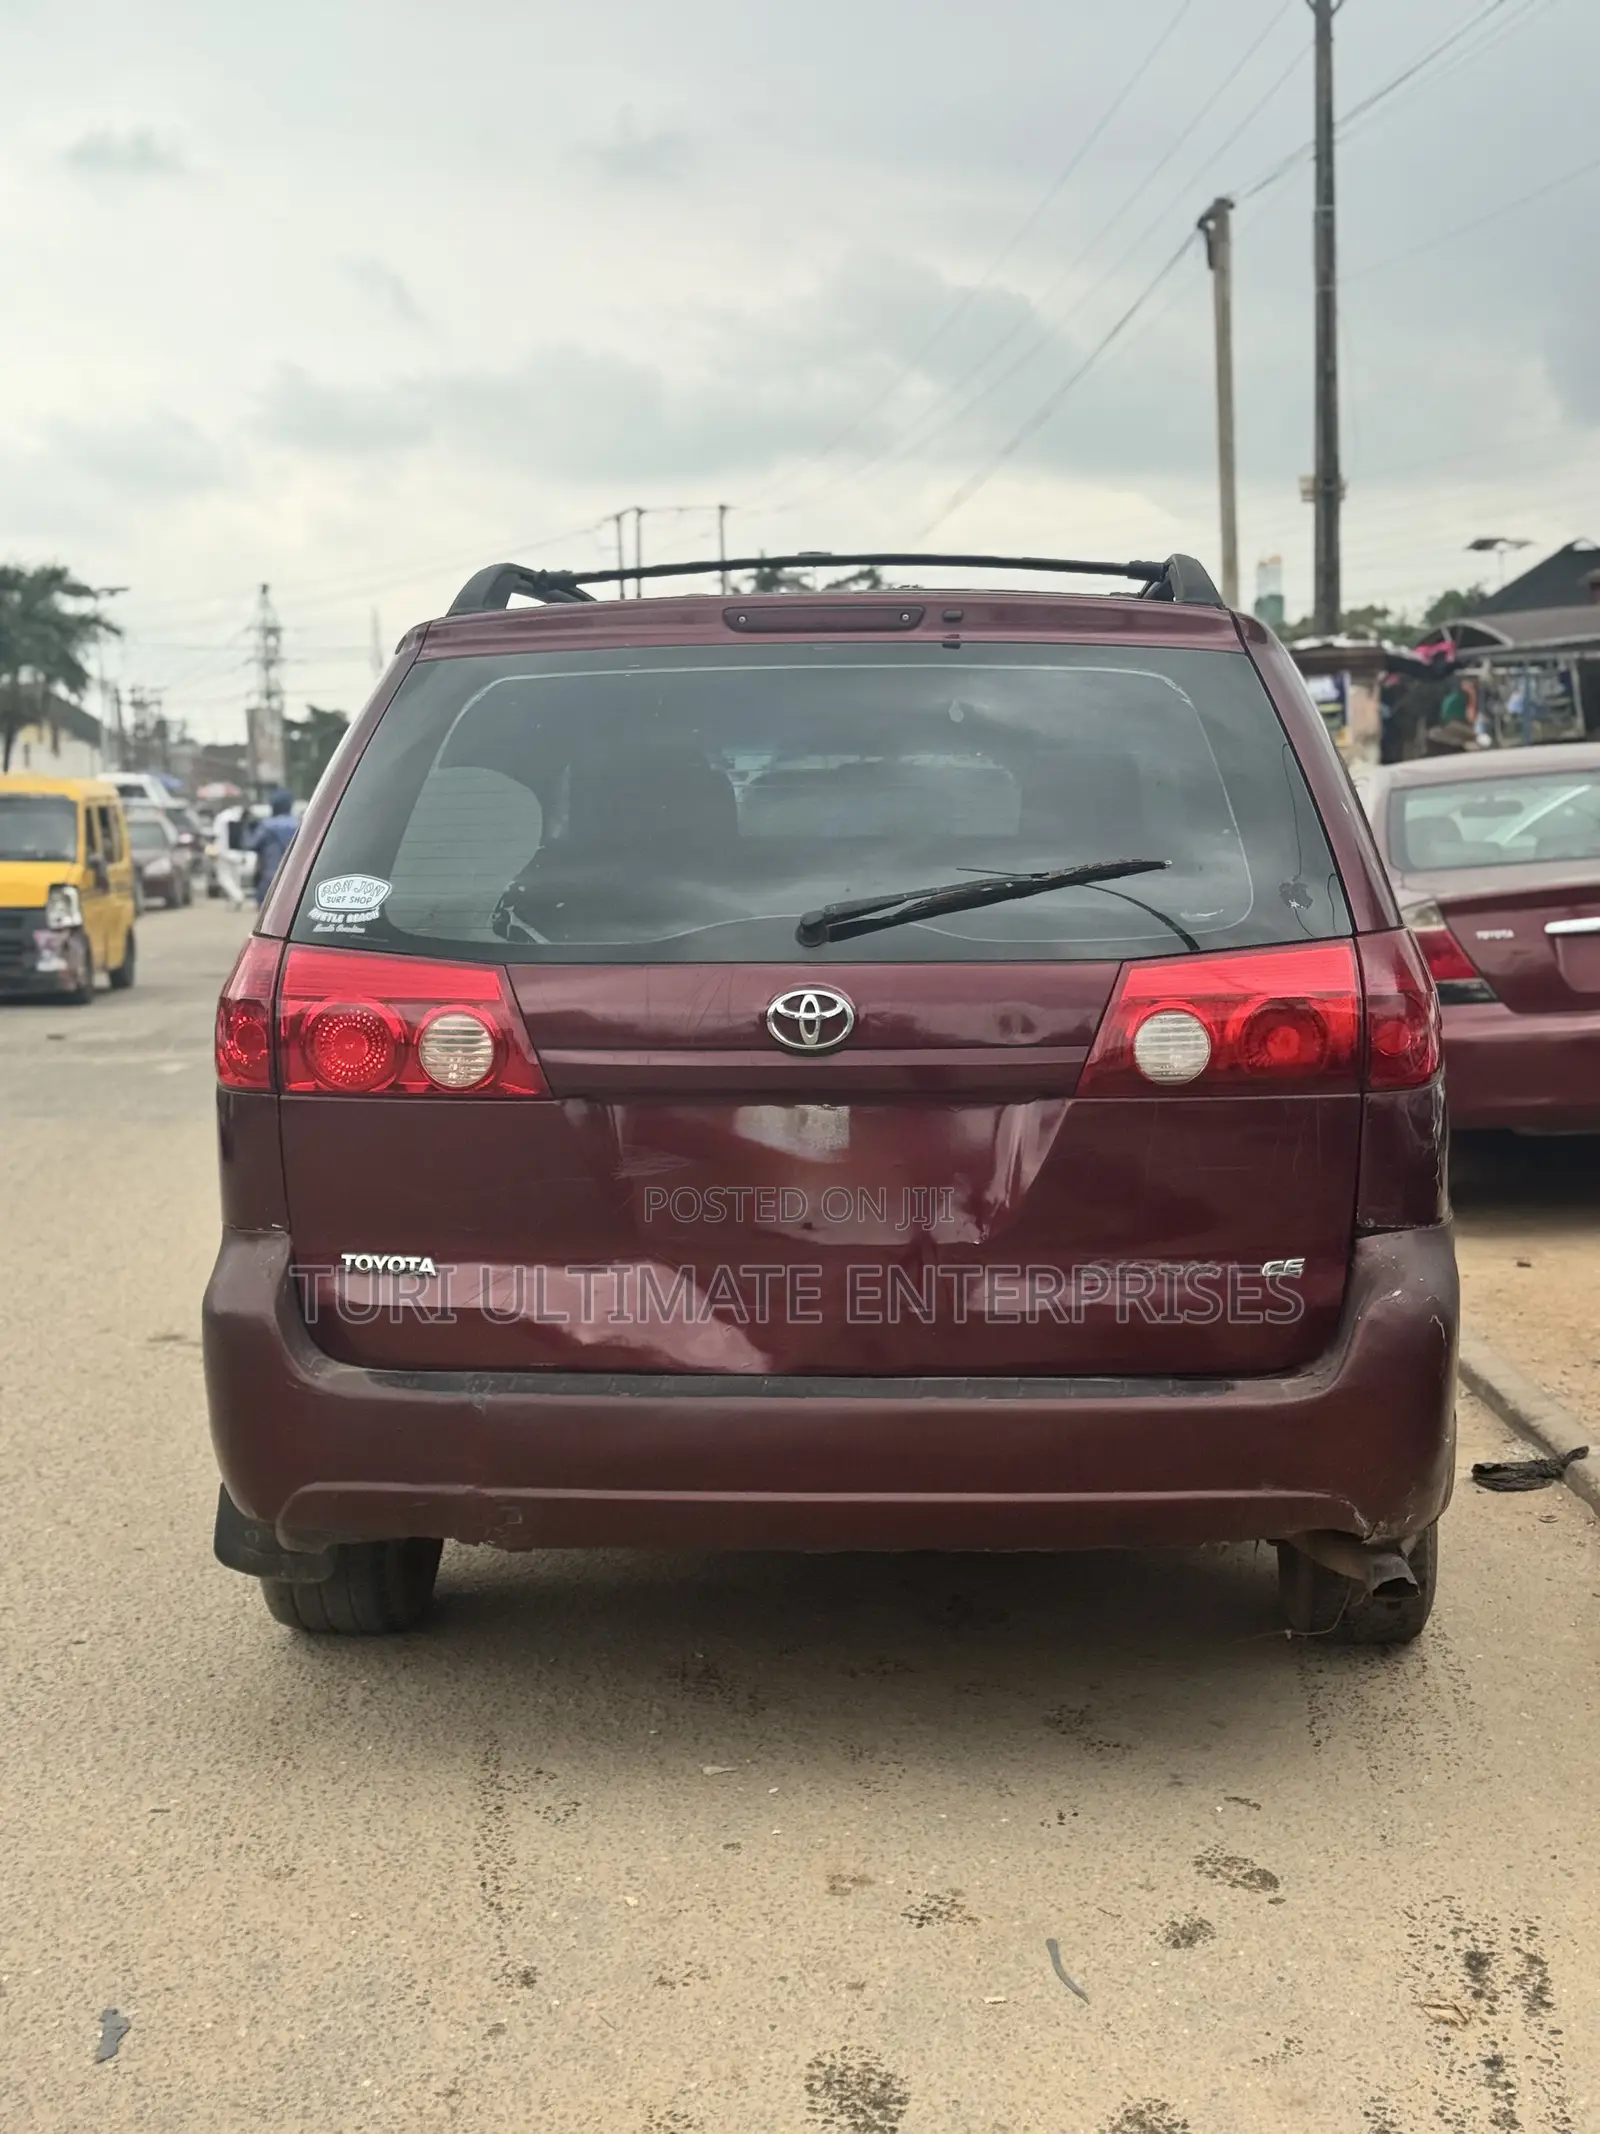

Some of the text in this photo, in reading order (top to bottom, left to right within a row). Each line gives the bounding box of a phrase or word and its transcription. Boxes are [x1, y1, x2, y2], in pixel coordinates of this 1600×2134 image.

[321, 880, 386, 898] RON JON
[325, 896, 373, 905] SURF SHOP
[340, 1253, 437, 1277] TOYOTA
[1261, 1258, 1306, 1278] CE
